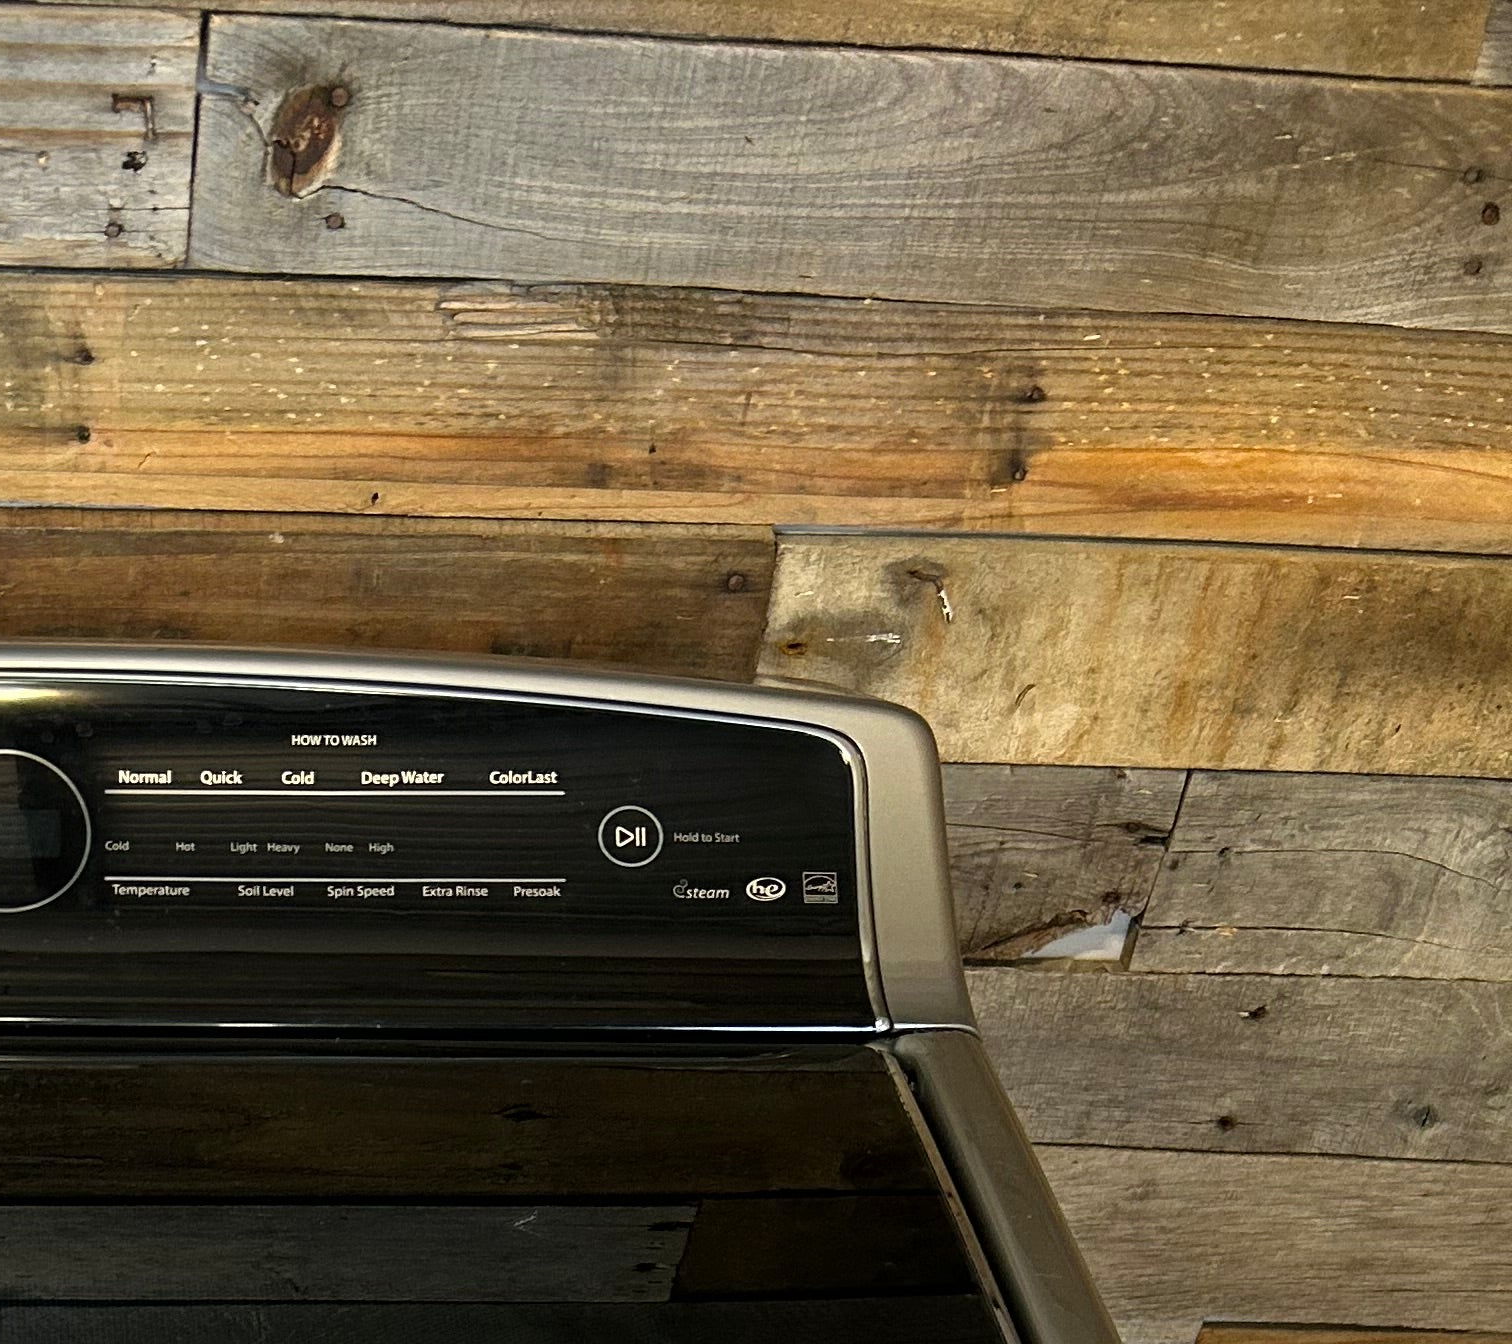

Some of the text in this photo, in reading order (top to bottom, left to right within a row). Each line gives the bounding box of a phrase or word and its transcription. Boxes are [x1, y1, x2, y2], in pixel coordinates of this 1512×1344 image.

[291, 734, 377, 747] HOW TO WASH
[118, 769, 172, 785] Normal
[199, 769, 243, 786] Quick
[281, 770, 315, 785] Cold
[360, 770, 445, 788] Deep Water
[489, 770, 558, 785] ColorLast
[673, 832, 740, 843] Hold to Start
[104, 840, 130, 852] Cold
[175, 841, 196, 852] Hot
[230, 841, 259, 855] Light
[266, 842, 301, 855] Heavy
[324, 842, 355, 853] None
[368, 842, 395, 855] High
[111, 883, 191, 898] Temperature
[237, 884, 295, 897] Soil Level
[326, 885, 395, 900] Spin Speed
[422, 885, 489, 897] Extra Rinse
[513, 885, 562, 897] Presoak
[684, 883, 730, 899] steam
